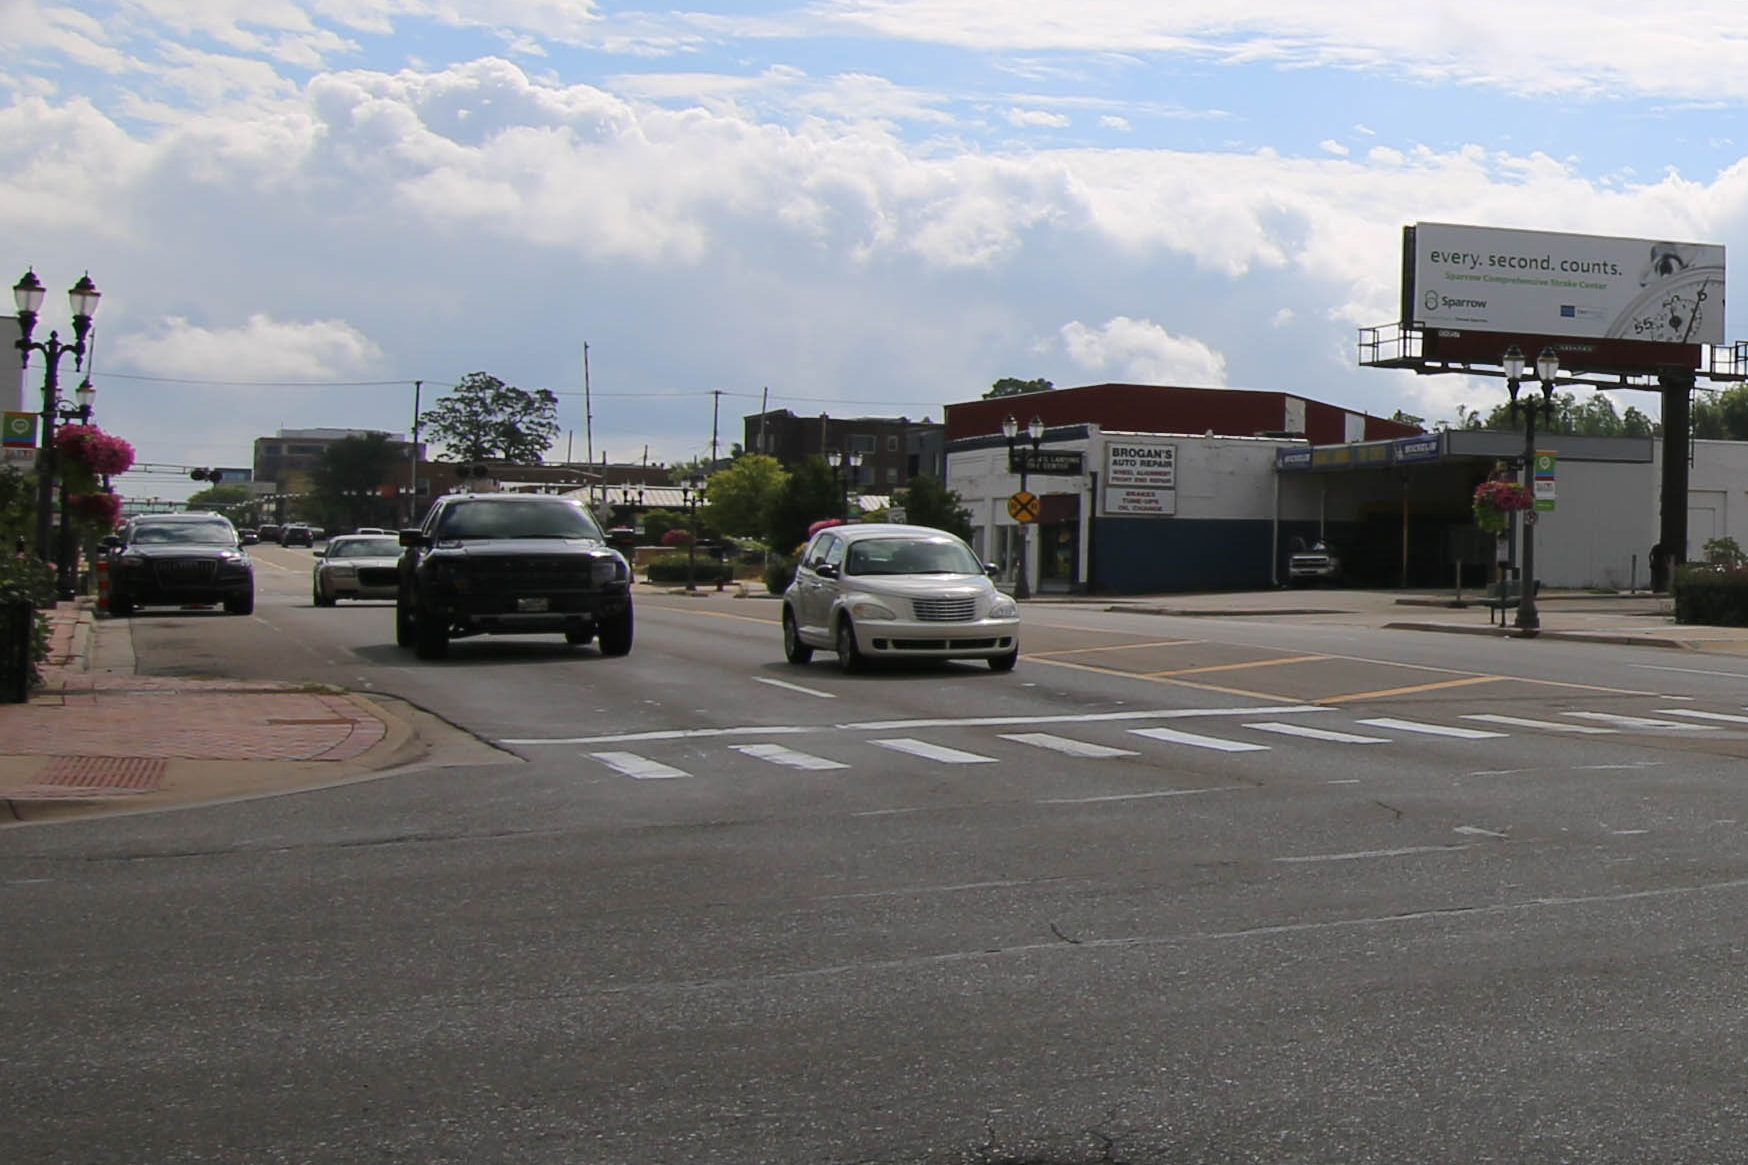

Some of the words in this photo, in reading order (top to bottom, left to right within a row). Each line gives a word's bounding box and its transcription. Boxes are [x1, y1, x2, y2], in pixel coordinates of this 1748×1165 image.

[1430, 250, 1483, 270] every.
[1488, 254, 1556, 272] second.
[1560, 259, 1623, 276] counts.
[1441, 295, 1488, 309] Sparrow
[1112, 447, 1173, 460] BROGAN'S
[1112, 459, 1137, 467] AUTO
[1140, 460, 1173, 468] REPAIR
